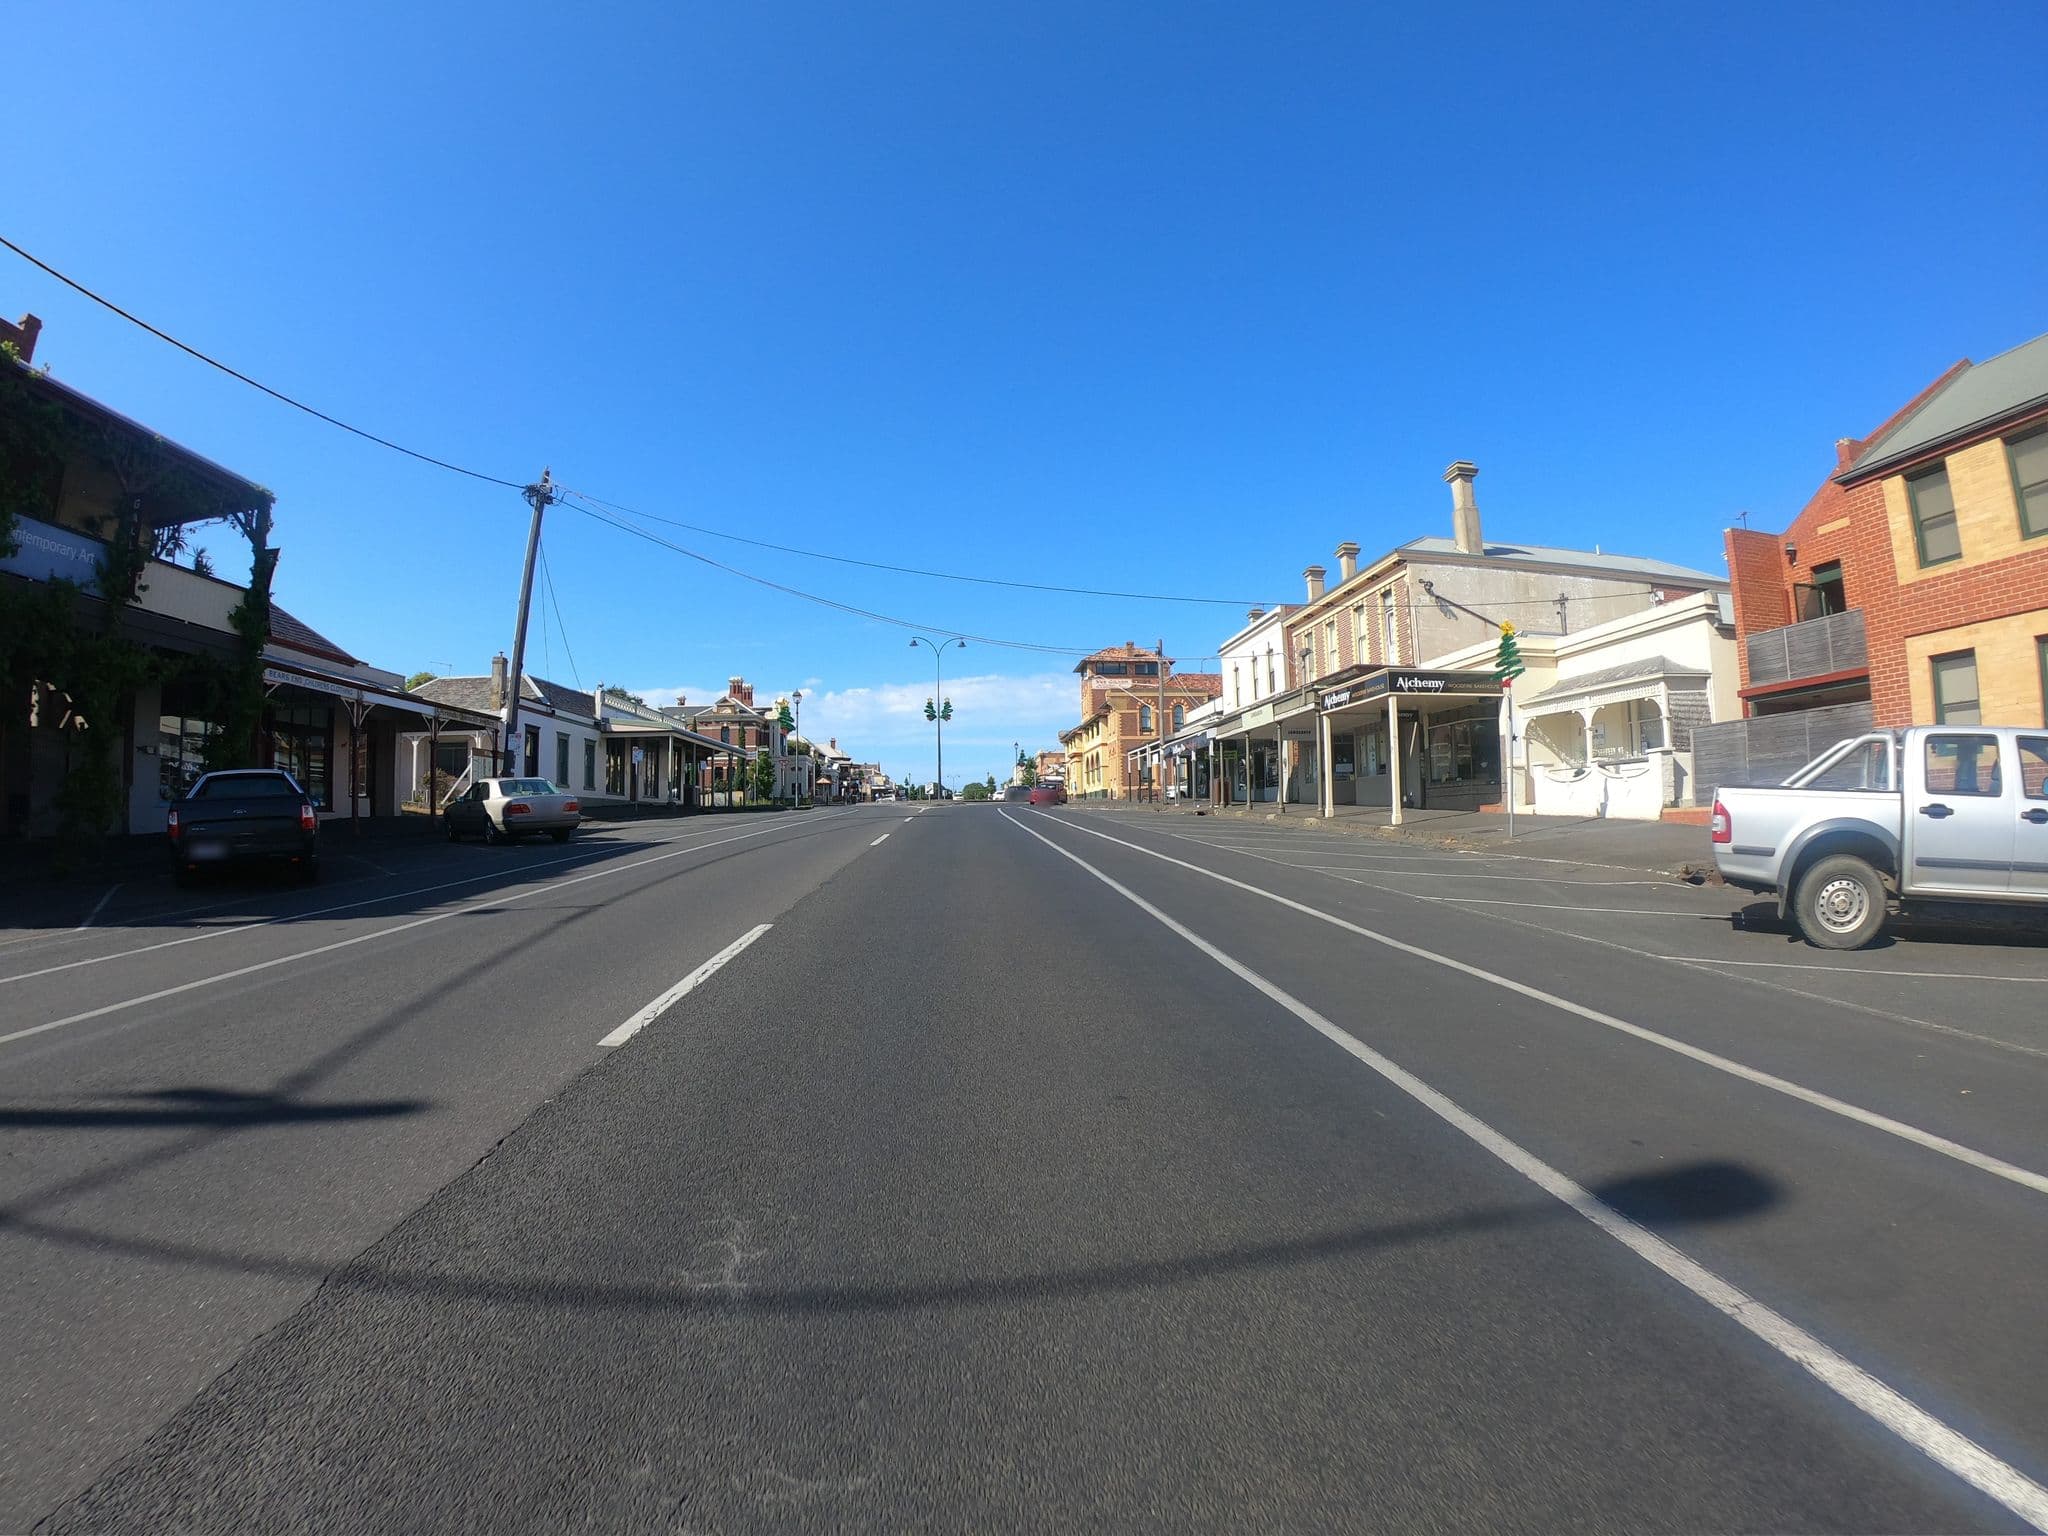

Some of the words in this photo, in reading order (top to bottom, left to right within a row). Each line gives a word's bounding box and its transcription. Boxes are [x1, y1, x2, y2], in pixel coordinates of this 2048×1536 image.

[79, 549, 95, 564] Art
[269, 670, 289, 680] BEARS
[1397, 676, 1446, 693] Alchemy
[1324, 691, 1351, 710] Alchemy
